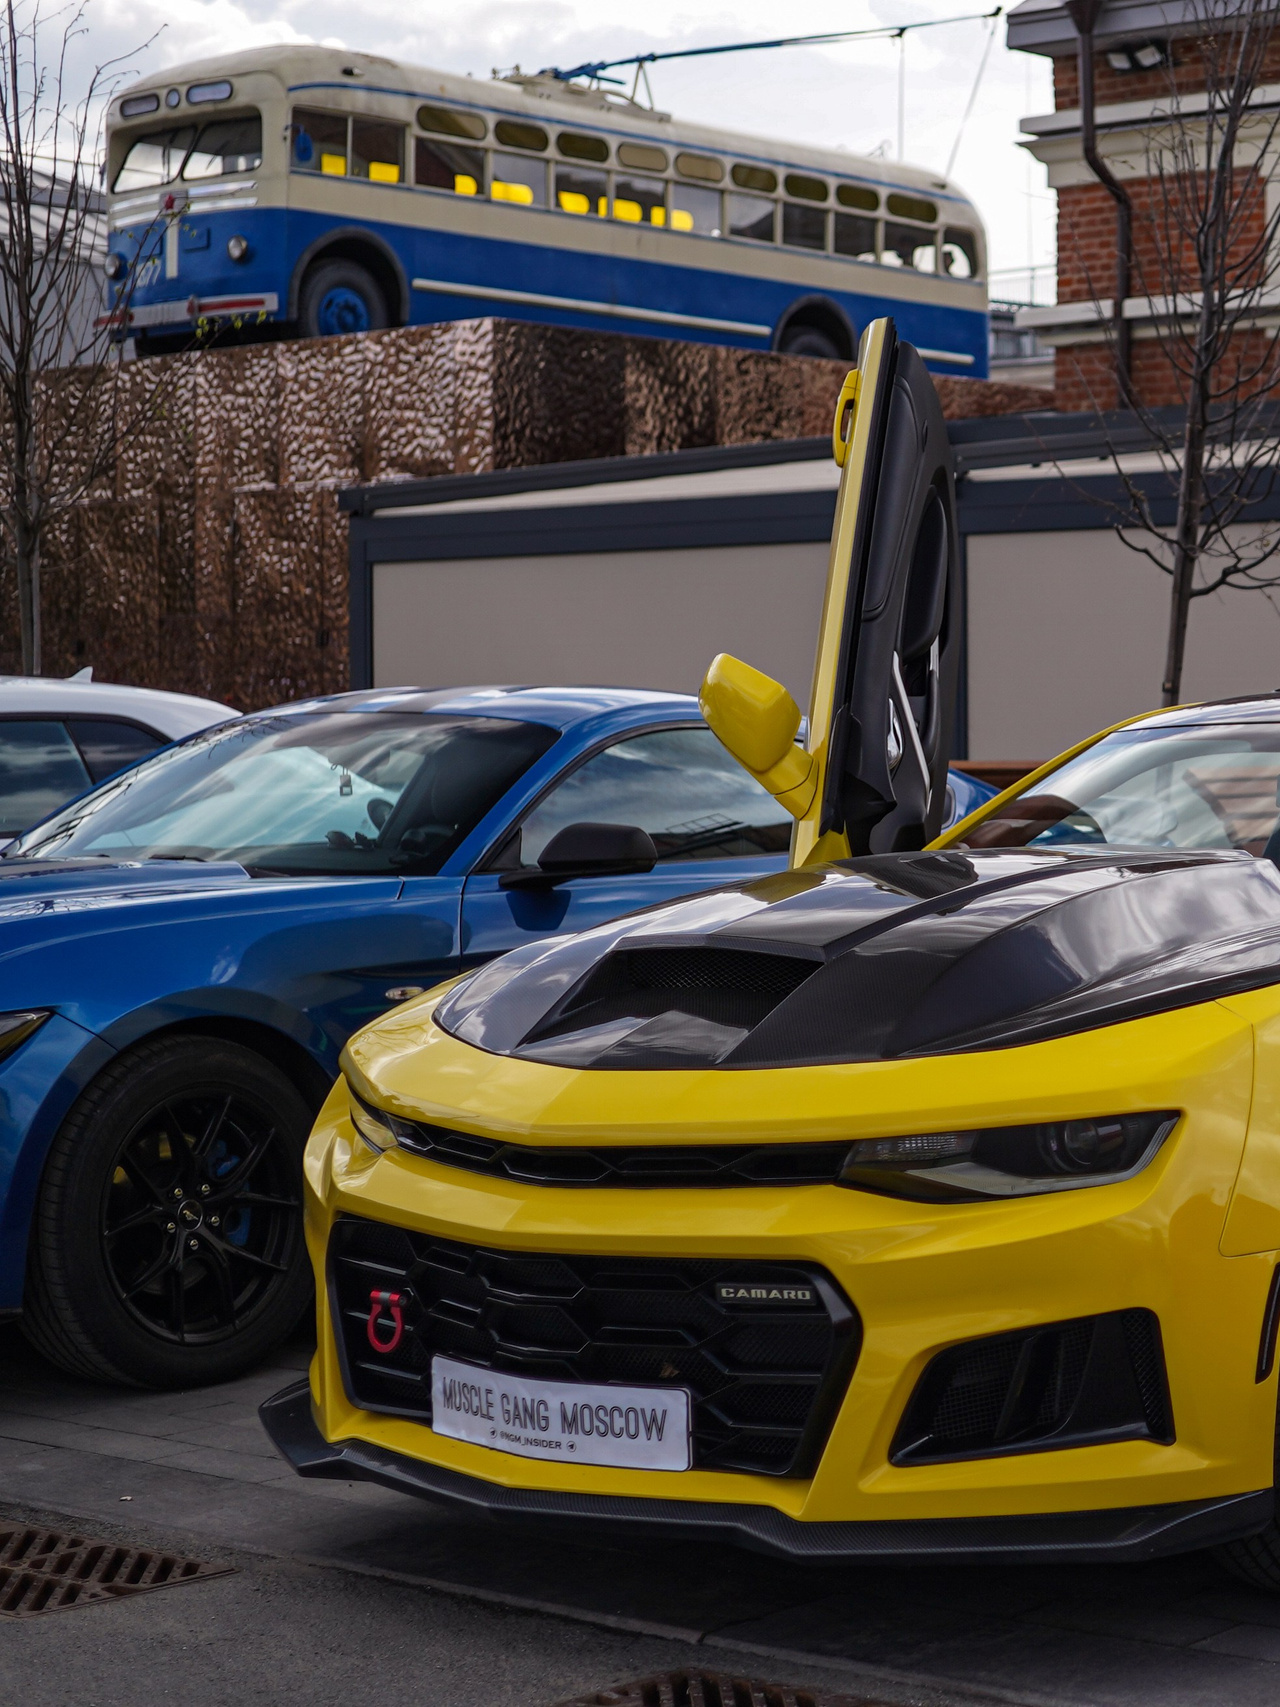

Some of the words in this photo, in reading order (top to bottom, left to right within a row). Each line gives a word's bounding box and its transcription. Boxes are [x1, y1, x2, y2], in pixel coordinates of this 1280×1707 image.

[721, 1288, 811, 1300] CAMARO
[442, 1376, 495, 1421] MUSCLE
[500, 1392, 550, 1432] GANG
[560, 1401, 668, 1442] MOSCOW
